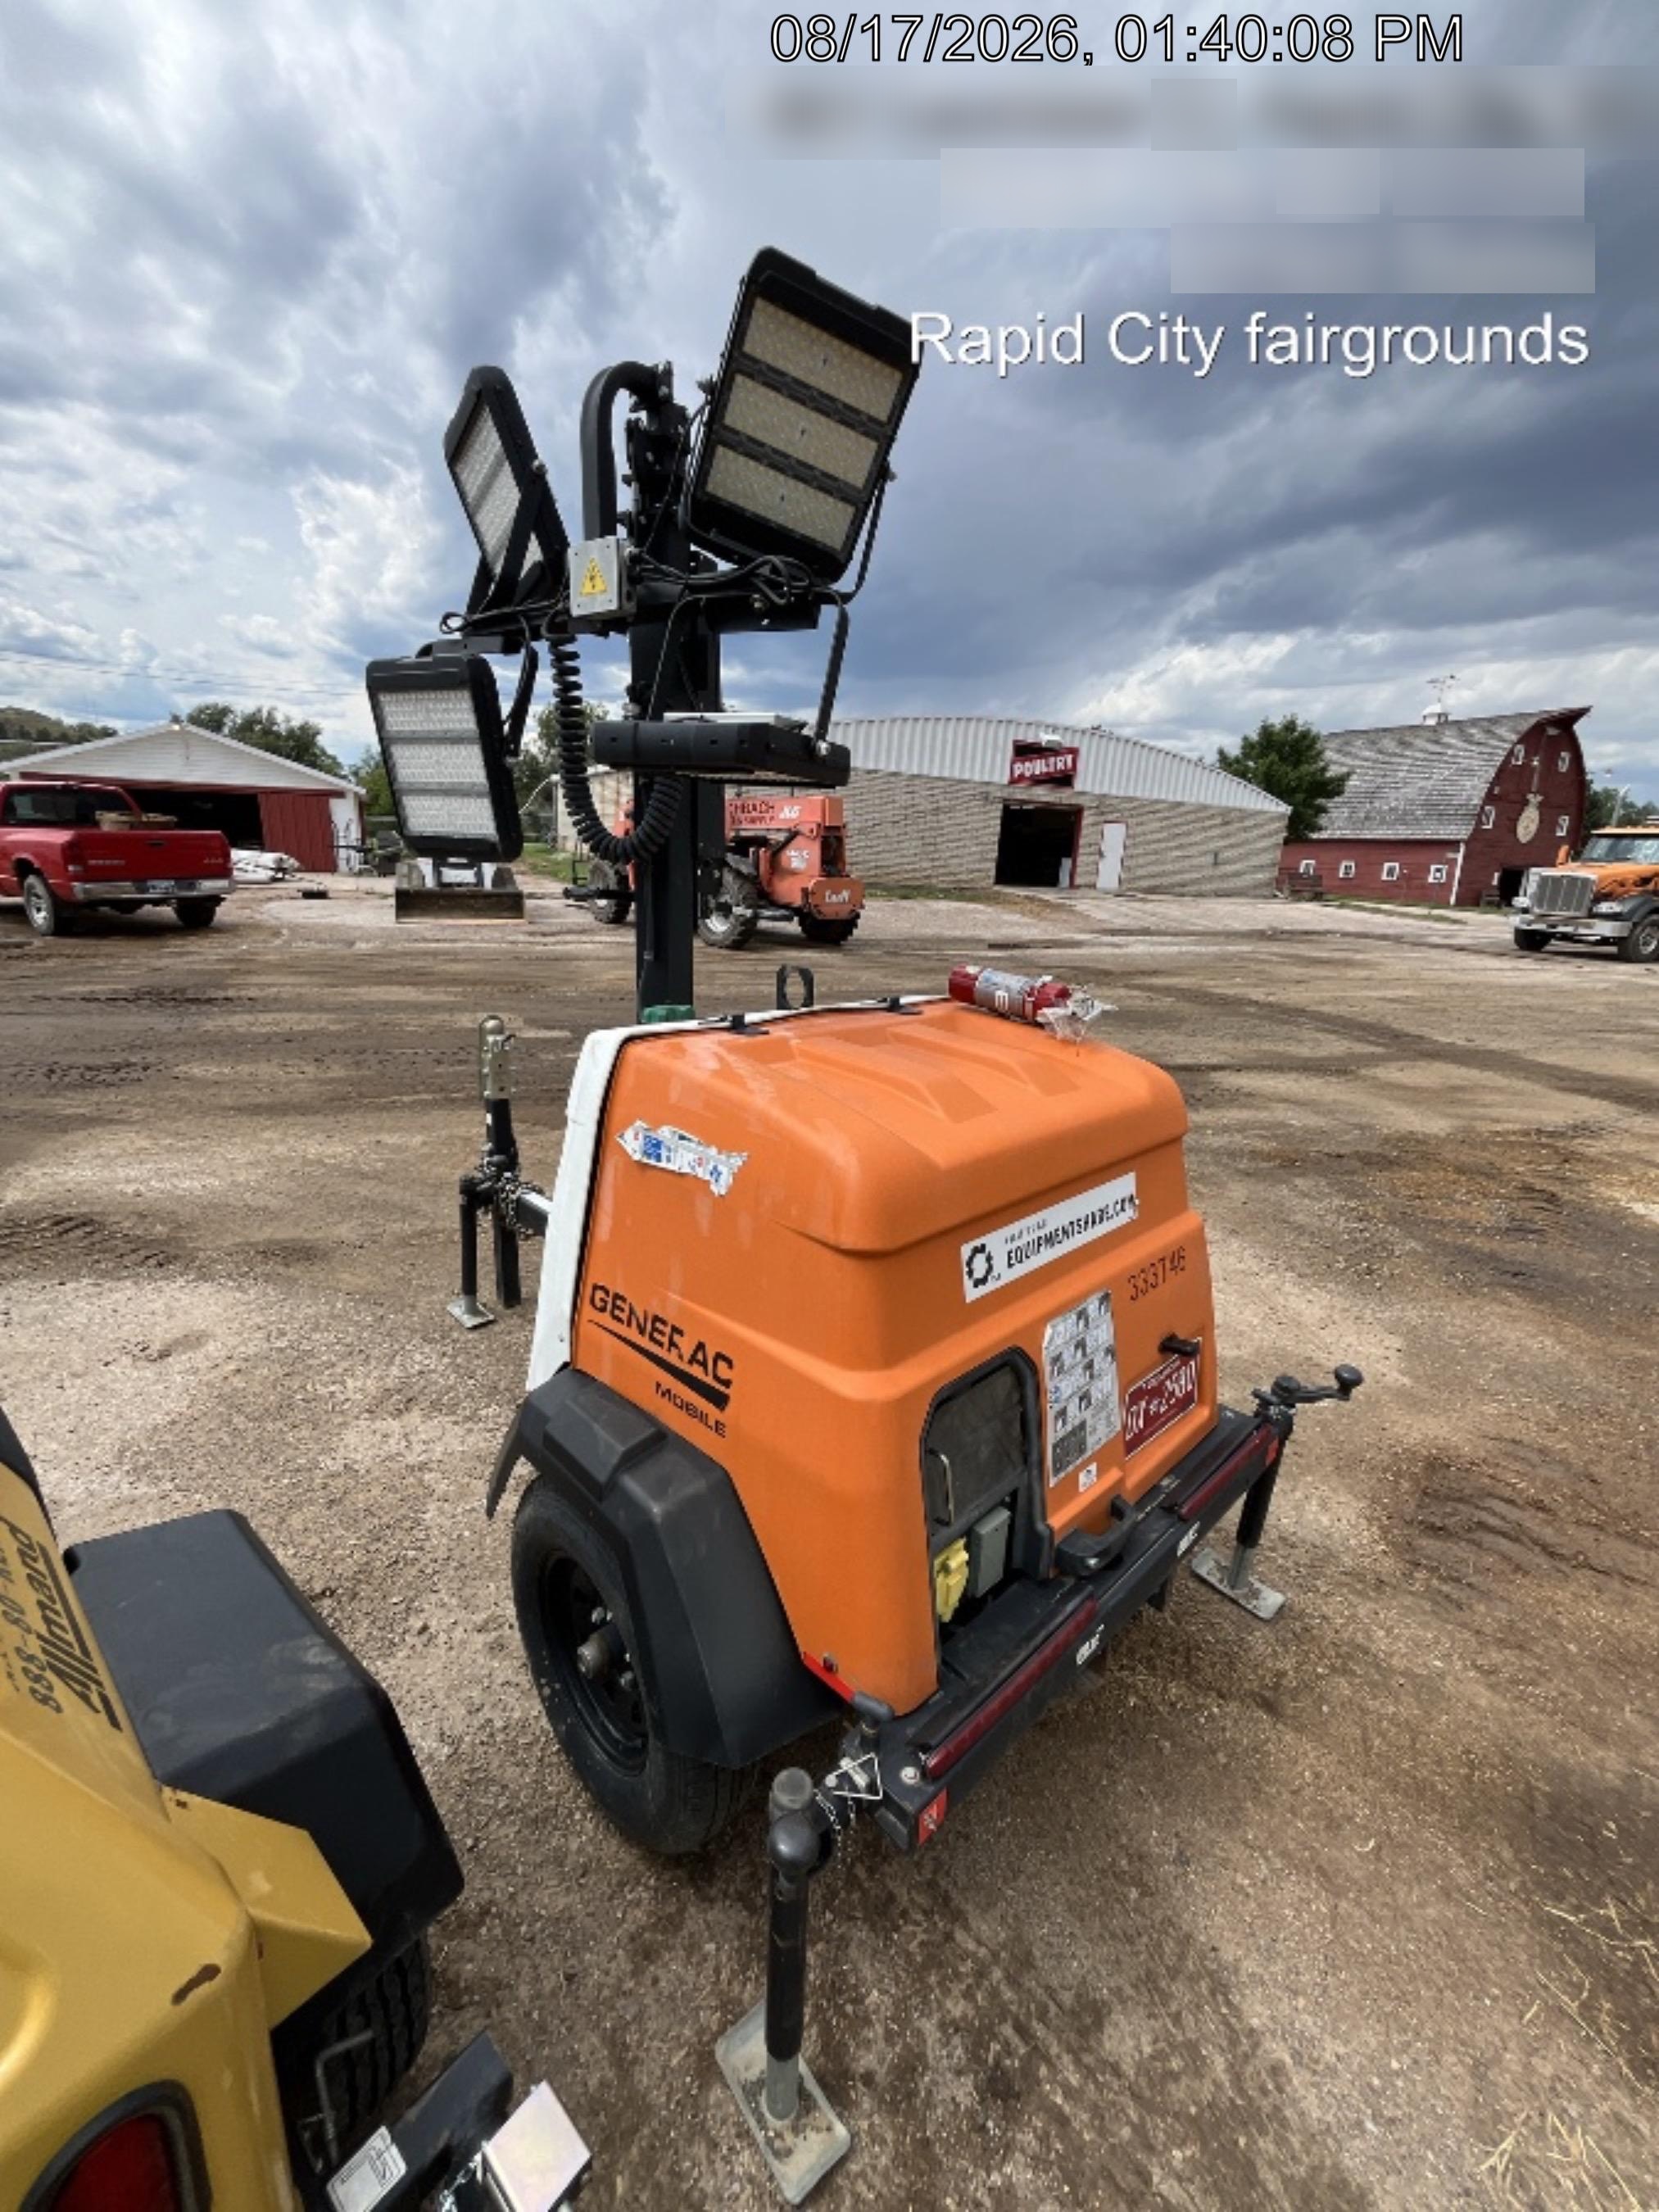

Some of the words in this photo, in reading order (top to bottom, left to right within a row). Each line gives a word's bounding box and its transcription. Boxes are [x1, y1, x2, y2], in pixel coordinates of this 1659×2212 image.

[1013, 754, 1073, 778] POULTRY
[1128, 1245, 1185, 1301] 333746
[589, 1283, 735, 1389] GENERAC
[655, 1380, 727, 1438] MOBILE
[0, 1516, 105, 1713] Allmand
